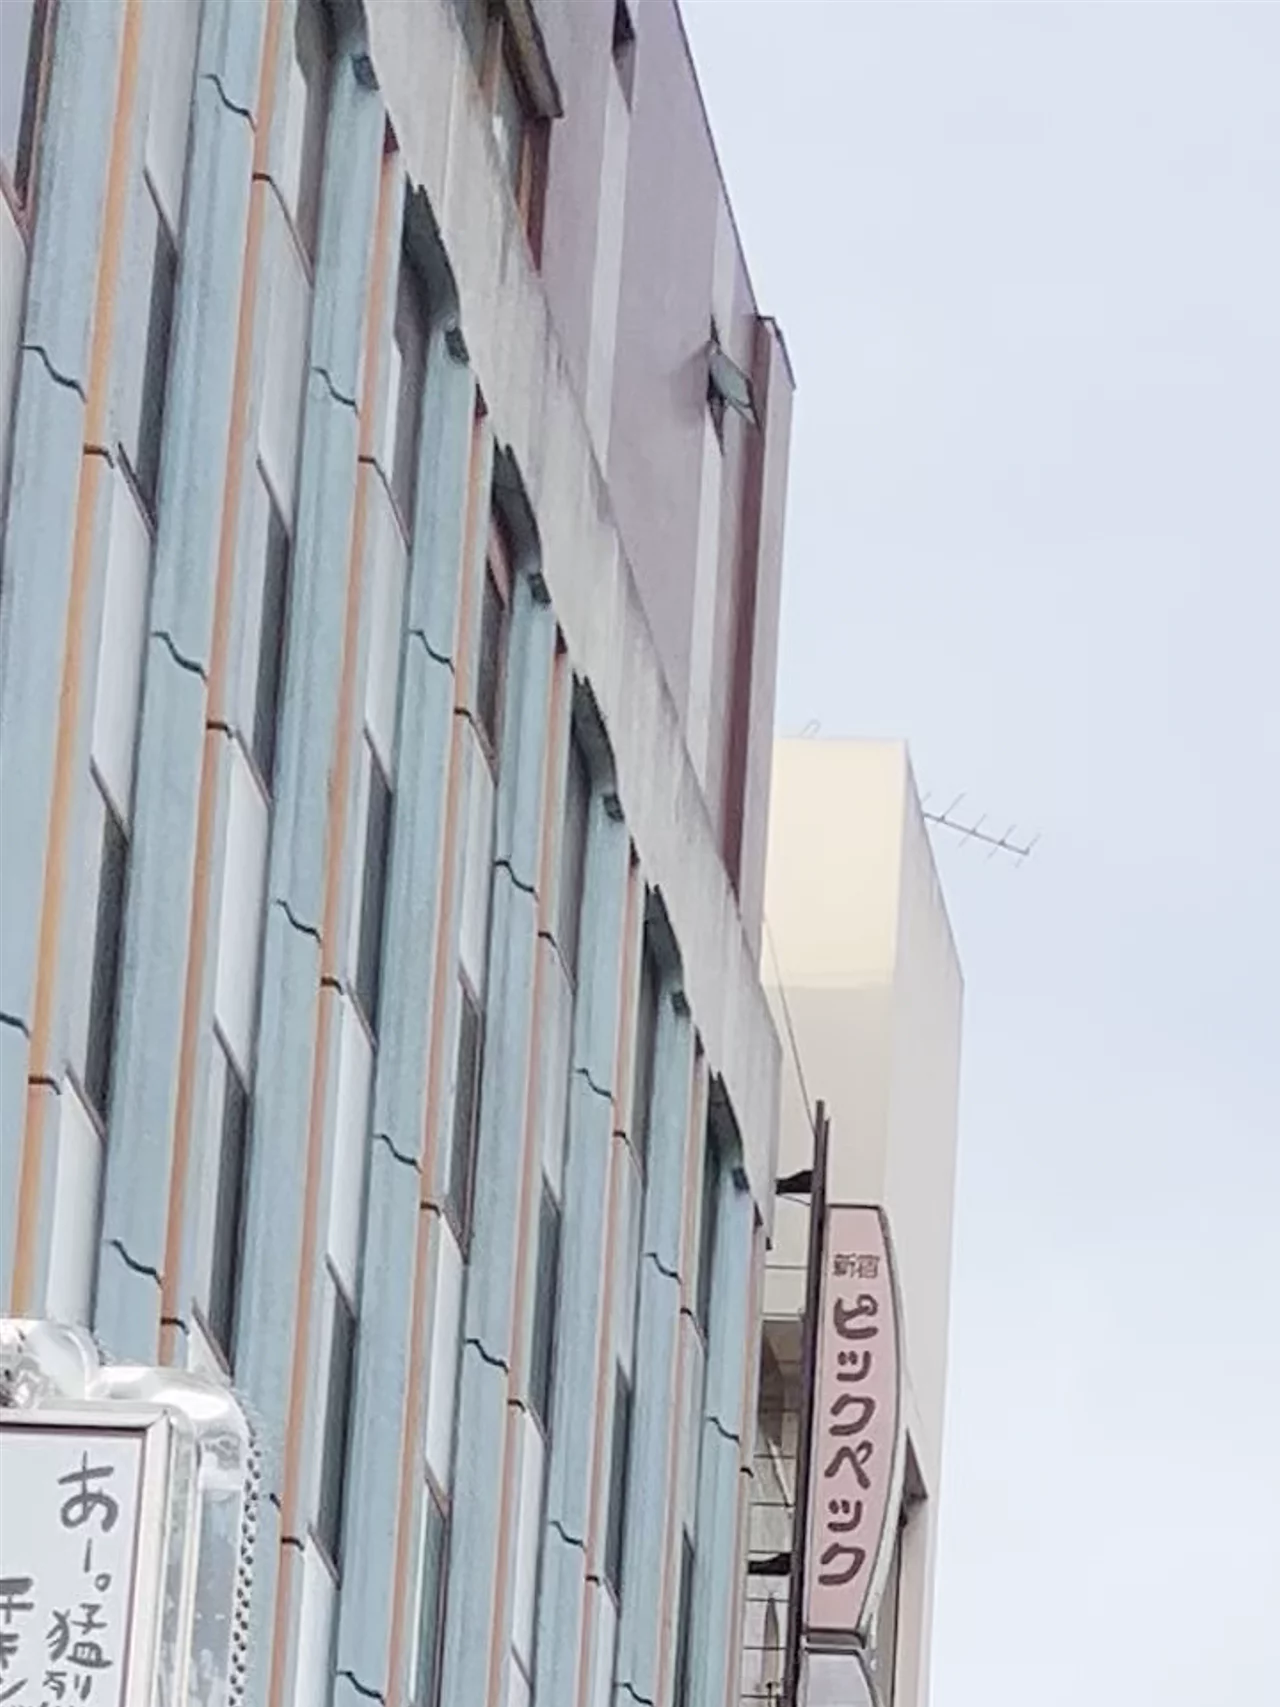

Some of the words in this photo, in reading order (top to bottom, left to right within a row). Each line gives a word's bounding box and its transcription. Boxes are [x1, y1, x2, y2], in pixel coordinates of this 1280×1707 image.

[833, 1253, 879, 1279] 新宿
[818, 1293, 881, 1587] ピックペック
